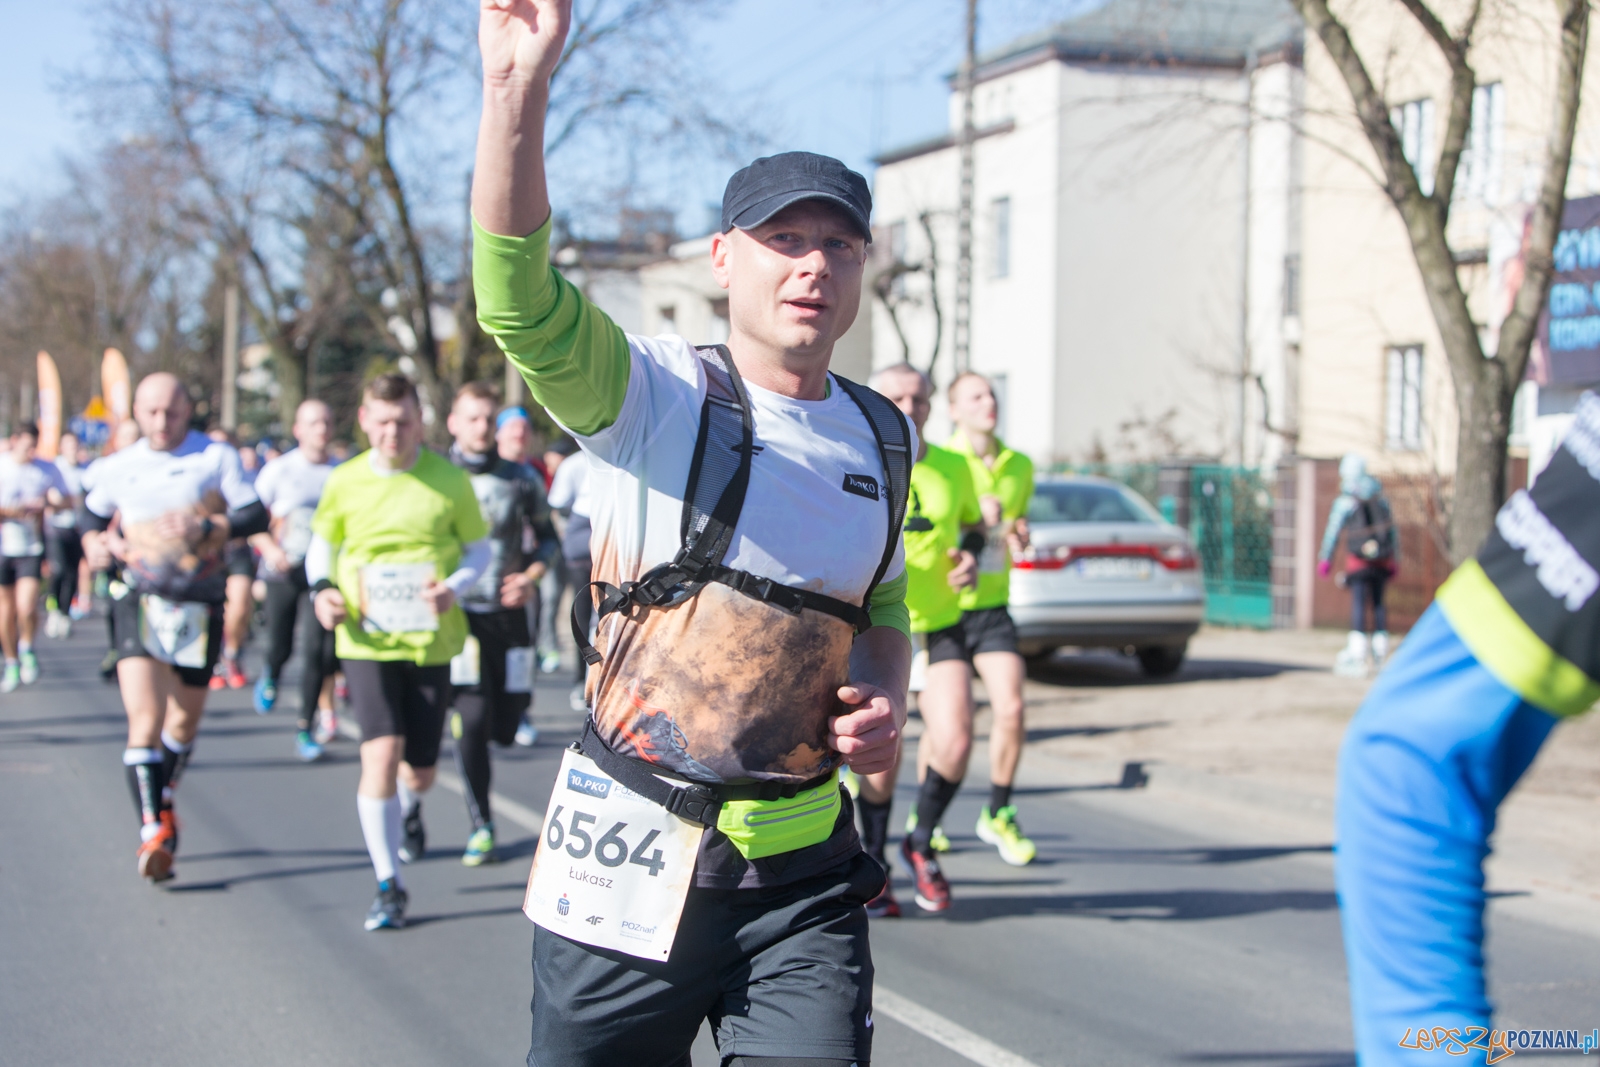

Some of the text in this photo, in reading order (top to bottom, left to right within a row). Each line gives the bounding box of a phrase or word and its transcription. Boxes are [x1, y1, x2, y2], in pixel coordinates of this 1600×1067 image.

[584, 779, 607, 793] PKO
[547, 804, 666, 877] 6564
[569, 866, 614, 889] Łukasz
[585, 915, 604, 926] 4F
